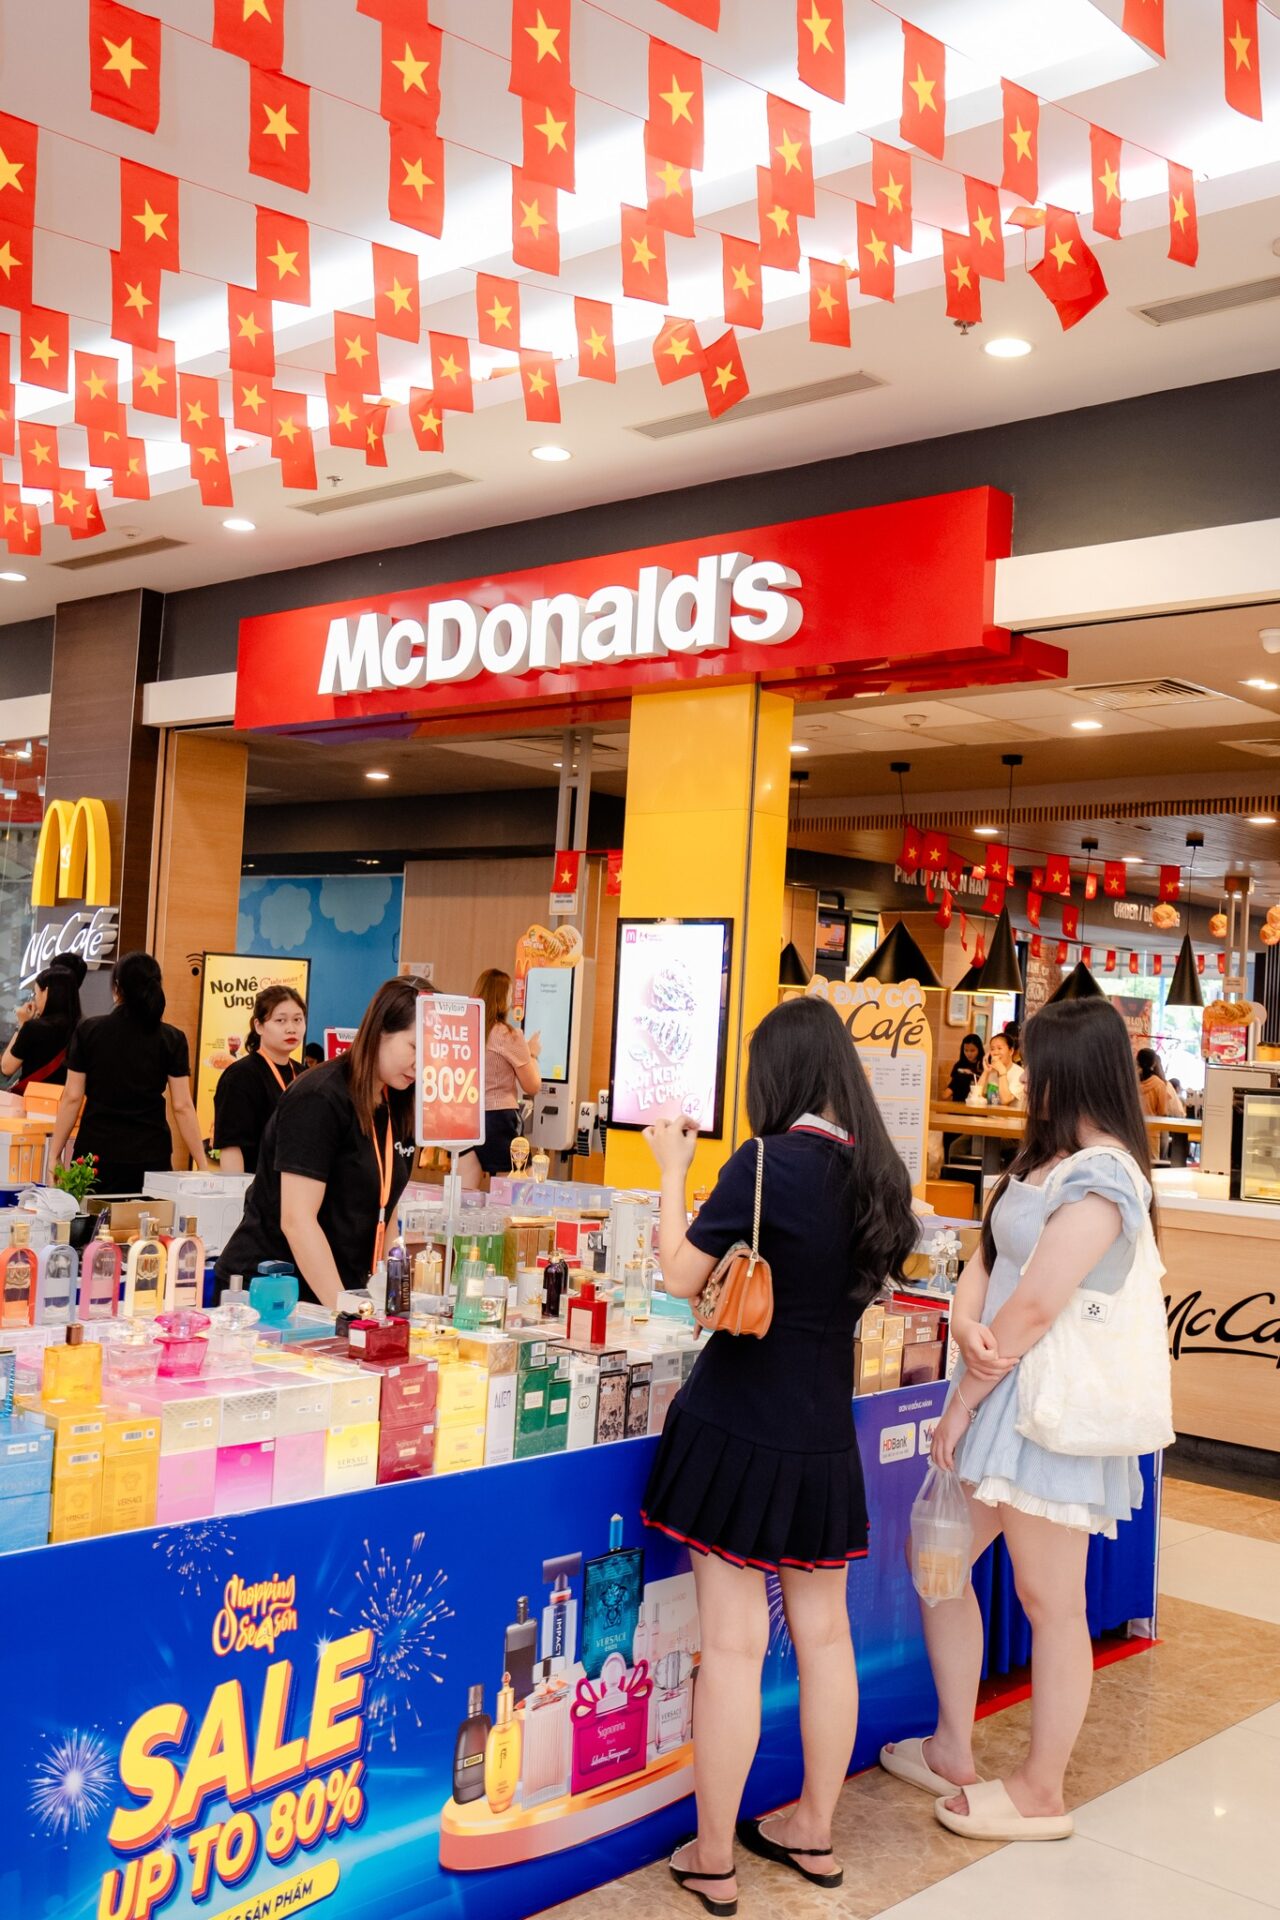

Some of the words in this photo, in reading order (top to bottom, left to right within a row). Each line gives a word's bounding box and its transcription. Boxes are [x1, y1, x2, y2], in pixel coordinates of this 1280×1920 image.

[317, 551, 804, 695] McDonald's
[1113, 901, 1139, 920] ORDER
[210, 979, 234, 994] No
[235, 976, 258, 991] Nê
[433, 1024, 469, 1042] SALE
[430, 1042, 449, 1059] UP
[452, 1044, 471, 1061] TO
[422, 1065, 479, 1104] 80%
[580, 1107, 590, 1117] 64
[883, 1435, 908, 1452] HDBank
[596, 1632, 626, 1648] VERSACE
[107, 1628, 376, 1852] SALE
[97, 1846, 178, 1920] UP
[188, 1810, 258, 1898] TO
[265, 1760, 366, 1861] 80%
